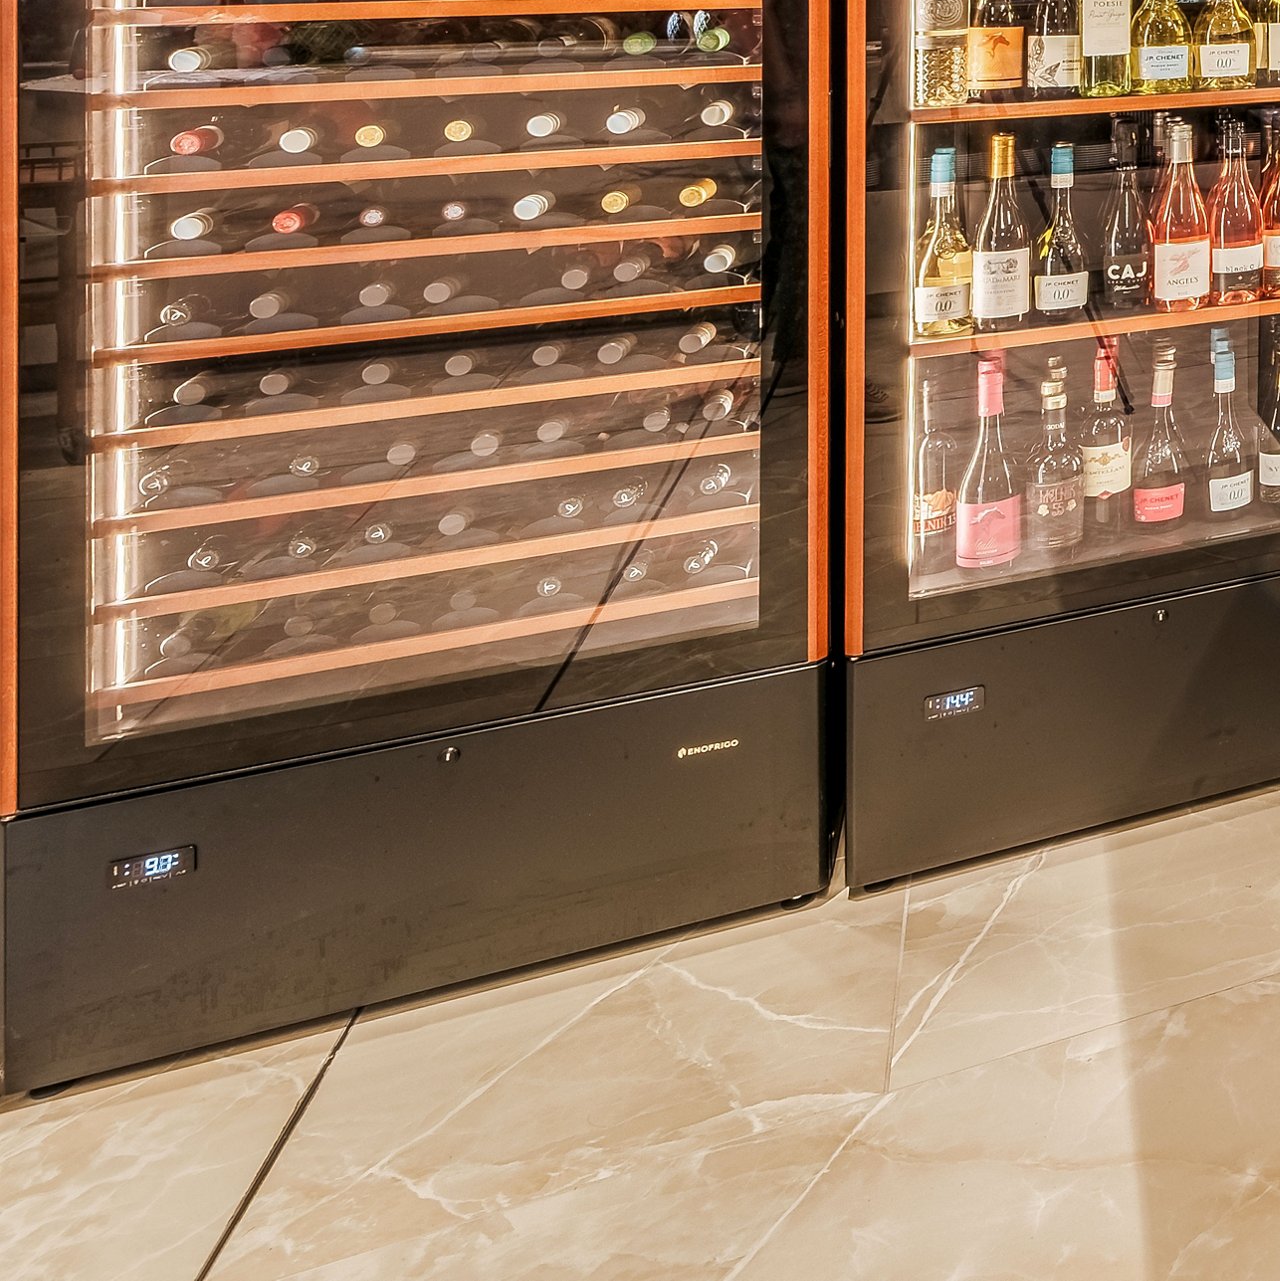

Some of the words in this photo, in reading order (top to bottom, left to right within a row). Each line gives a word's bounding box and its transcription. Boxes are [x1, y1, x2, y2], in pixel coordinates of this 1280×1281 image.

[1107, 261, 1147, 280] CAJ
[935, 290, 961, 298] CHENET
[1229, 478, 1249, 488] CHENET
[1149, 493, 1179, 503] CHENET
[1051, 501, 1065, 517] 55
[687, 739, 739, 756] ENOFRIGO
